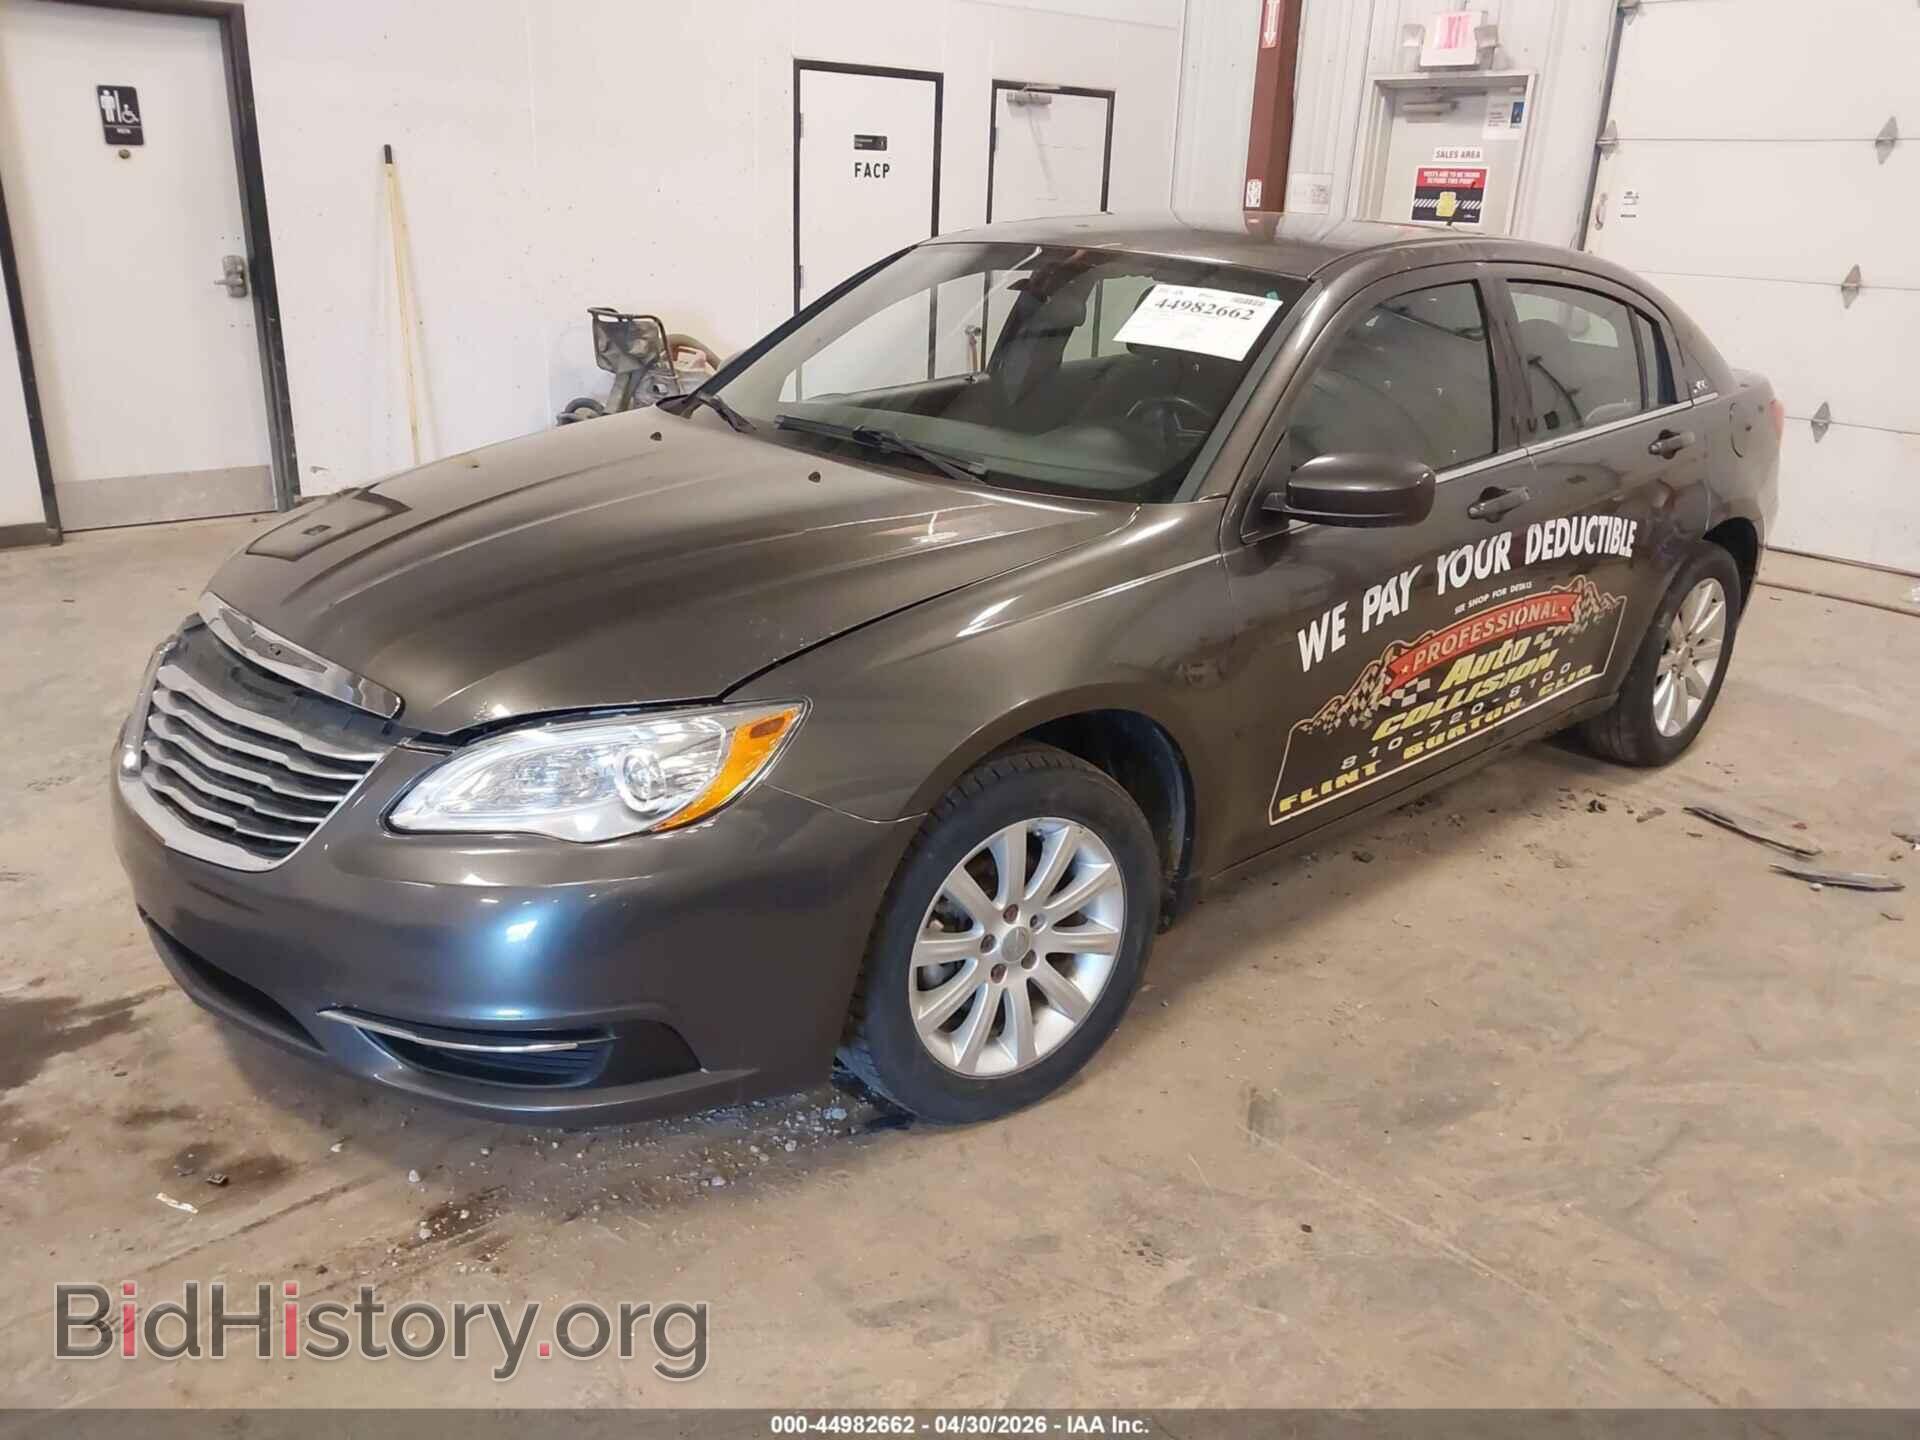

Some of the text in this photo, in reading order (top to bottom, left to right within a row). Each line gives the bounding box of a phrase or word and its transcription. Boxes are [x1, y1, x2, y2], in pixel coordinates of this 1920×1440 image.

[1435, 150, 1481, 159] SALES AREA
[854, 161, 890, 179] FACP
[1155, 298, 1255, 320] 44982662
[1297, 514, 1637, 673] WE PAY YOUR DEDUCTIBLE
[1468, 593, 1490, 609] SHOP
[1492, 587, 1507, 598] FOR
[1411, 601, 1559, 673] PROFESSIONAL
[1279, 759, 1382, 813] FLINT
[1403, 697, 1523, 761] BURTON
